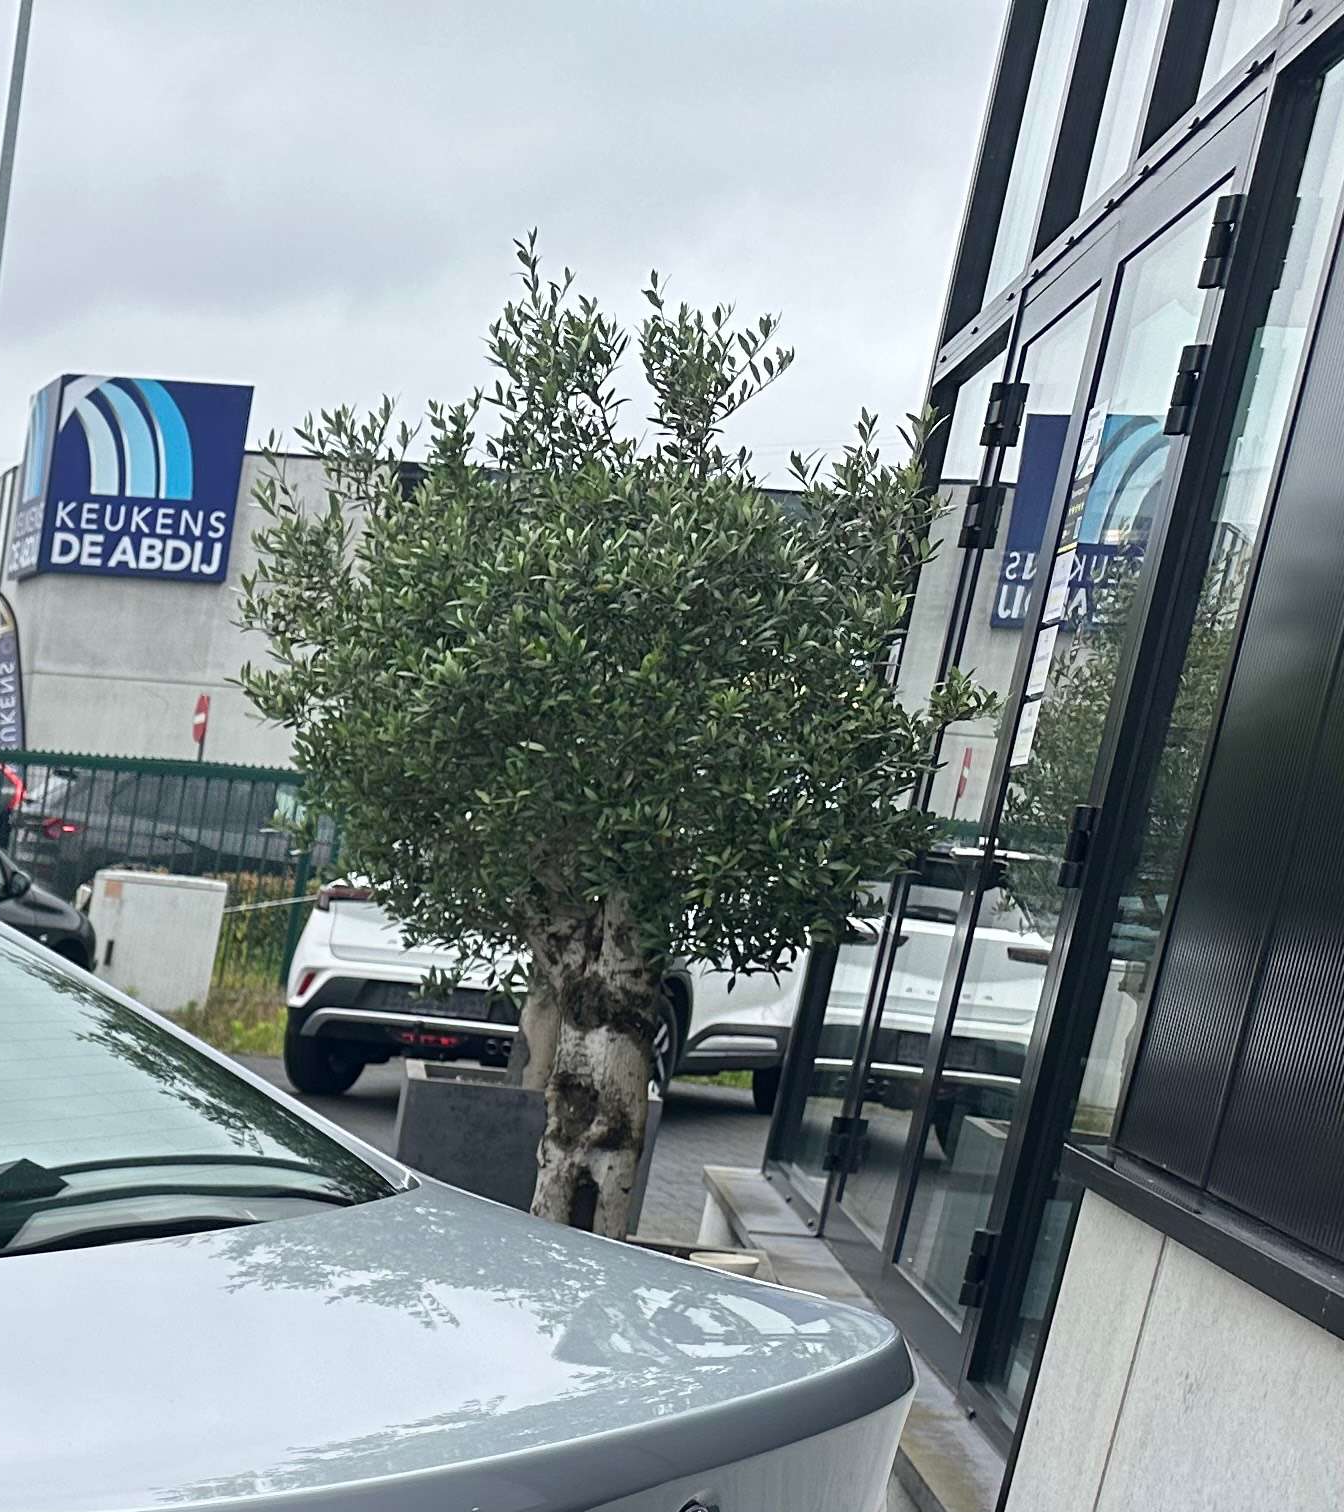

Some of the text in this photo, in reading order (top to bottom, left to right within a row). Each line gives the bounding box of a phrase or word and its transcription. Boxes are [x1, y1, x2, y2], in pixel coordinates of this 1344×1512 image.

[54, 500, 227, 539] KEUKENS
[50, 531, 105, 567] DE
[107, 535, 223, 575] ABDIJ
